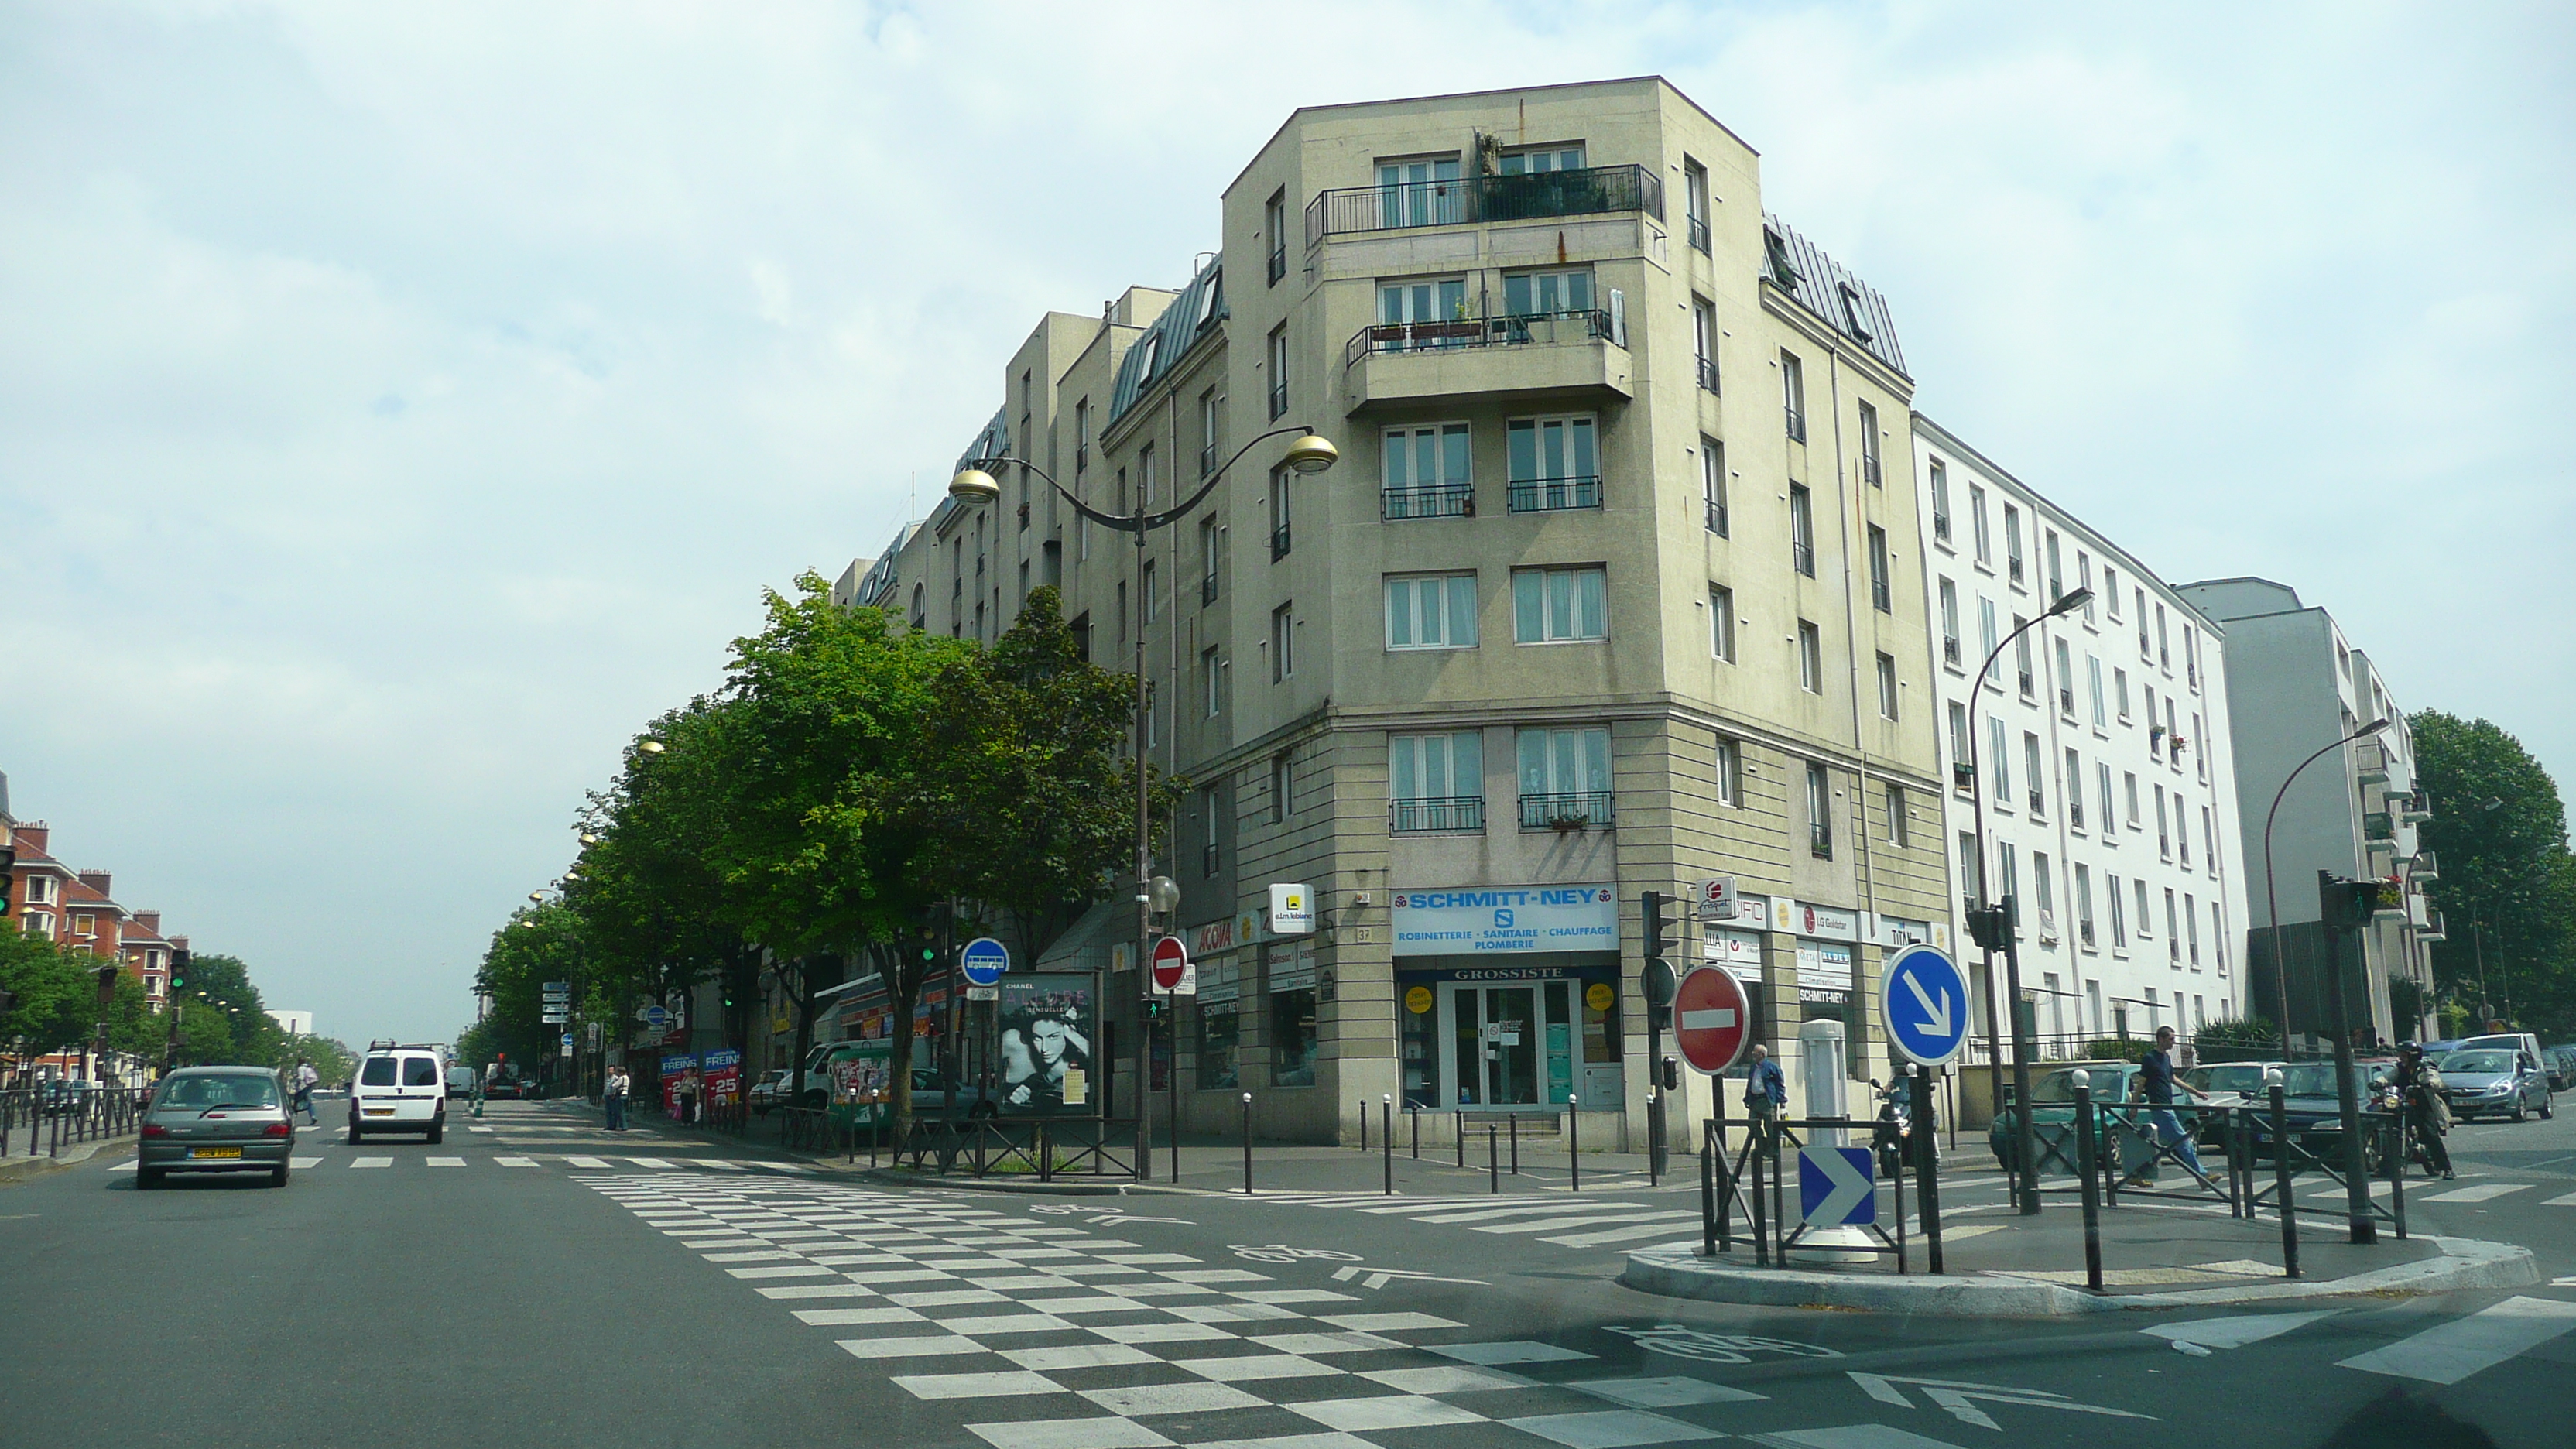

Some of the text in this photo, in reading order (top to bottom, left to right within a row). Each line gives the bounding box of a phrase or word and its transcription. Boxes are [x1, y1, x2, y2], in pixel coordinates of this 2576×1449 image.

[1410, 889, 1596, 909] SCHMITT-NEY
[1817, 916, 1824, 927] LG
[1197, 922, 1231, 953] ACOVA
[1358, 930, 1369, 940] 37
[1398, 927, 1612, 940] ROBINETTERIE SANITAIRE CHAUFFAGE
[1475, 940, 1534, 950] PLOMBERIE
[1822, 952, 1849, 961] ALDES
[1455, 968, 1564, 979] GROSSISTE
[1007, 989, 1084, 1005] ALLURE
[1800, 989, 1844, 1004] SCHMITT-NEY
[663, 1059, 697, 1070] FREINS
[711, 1078, 737, 1093] -25
